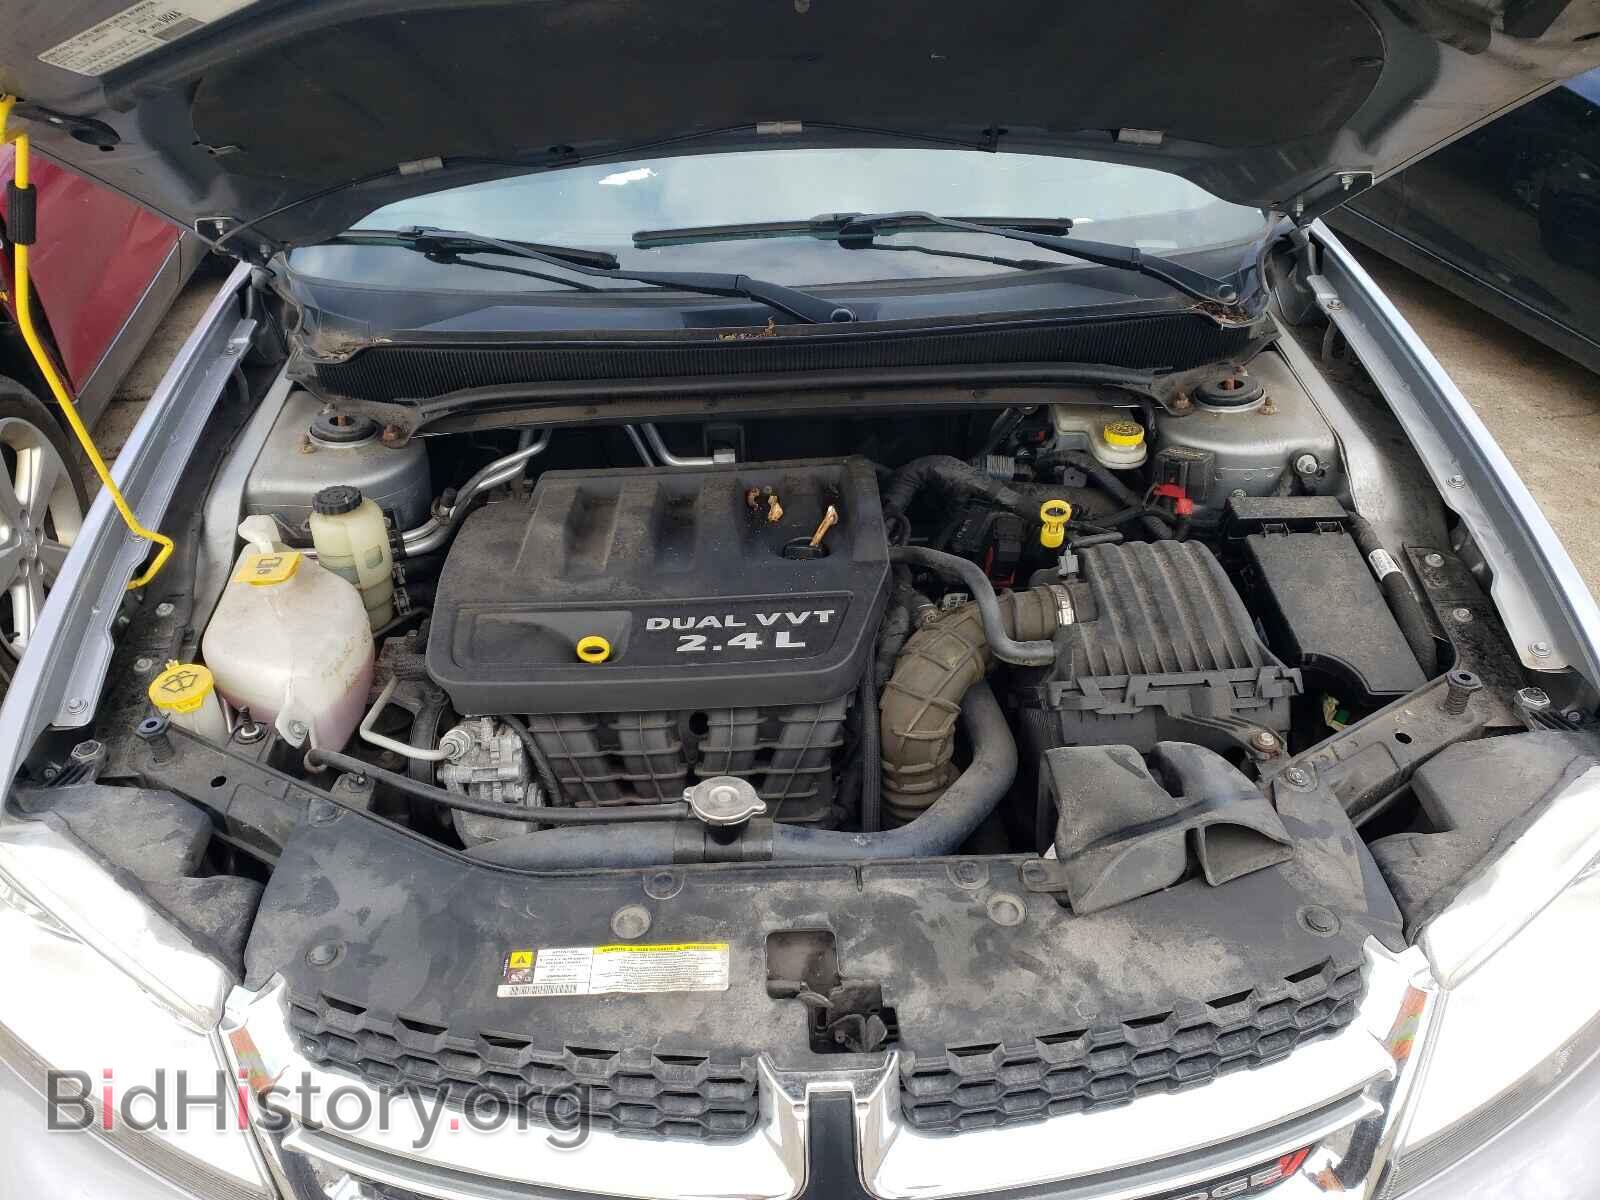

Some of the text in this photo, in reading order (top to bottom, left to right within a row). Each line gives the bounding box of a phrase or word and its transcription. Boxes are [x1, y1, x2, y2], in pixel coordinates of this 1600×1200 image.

[646, 609, 835, 630] DUAL VVT
[676, 632, 763, 652] 2.4
